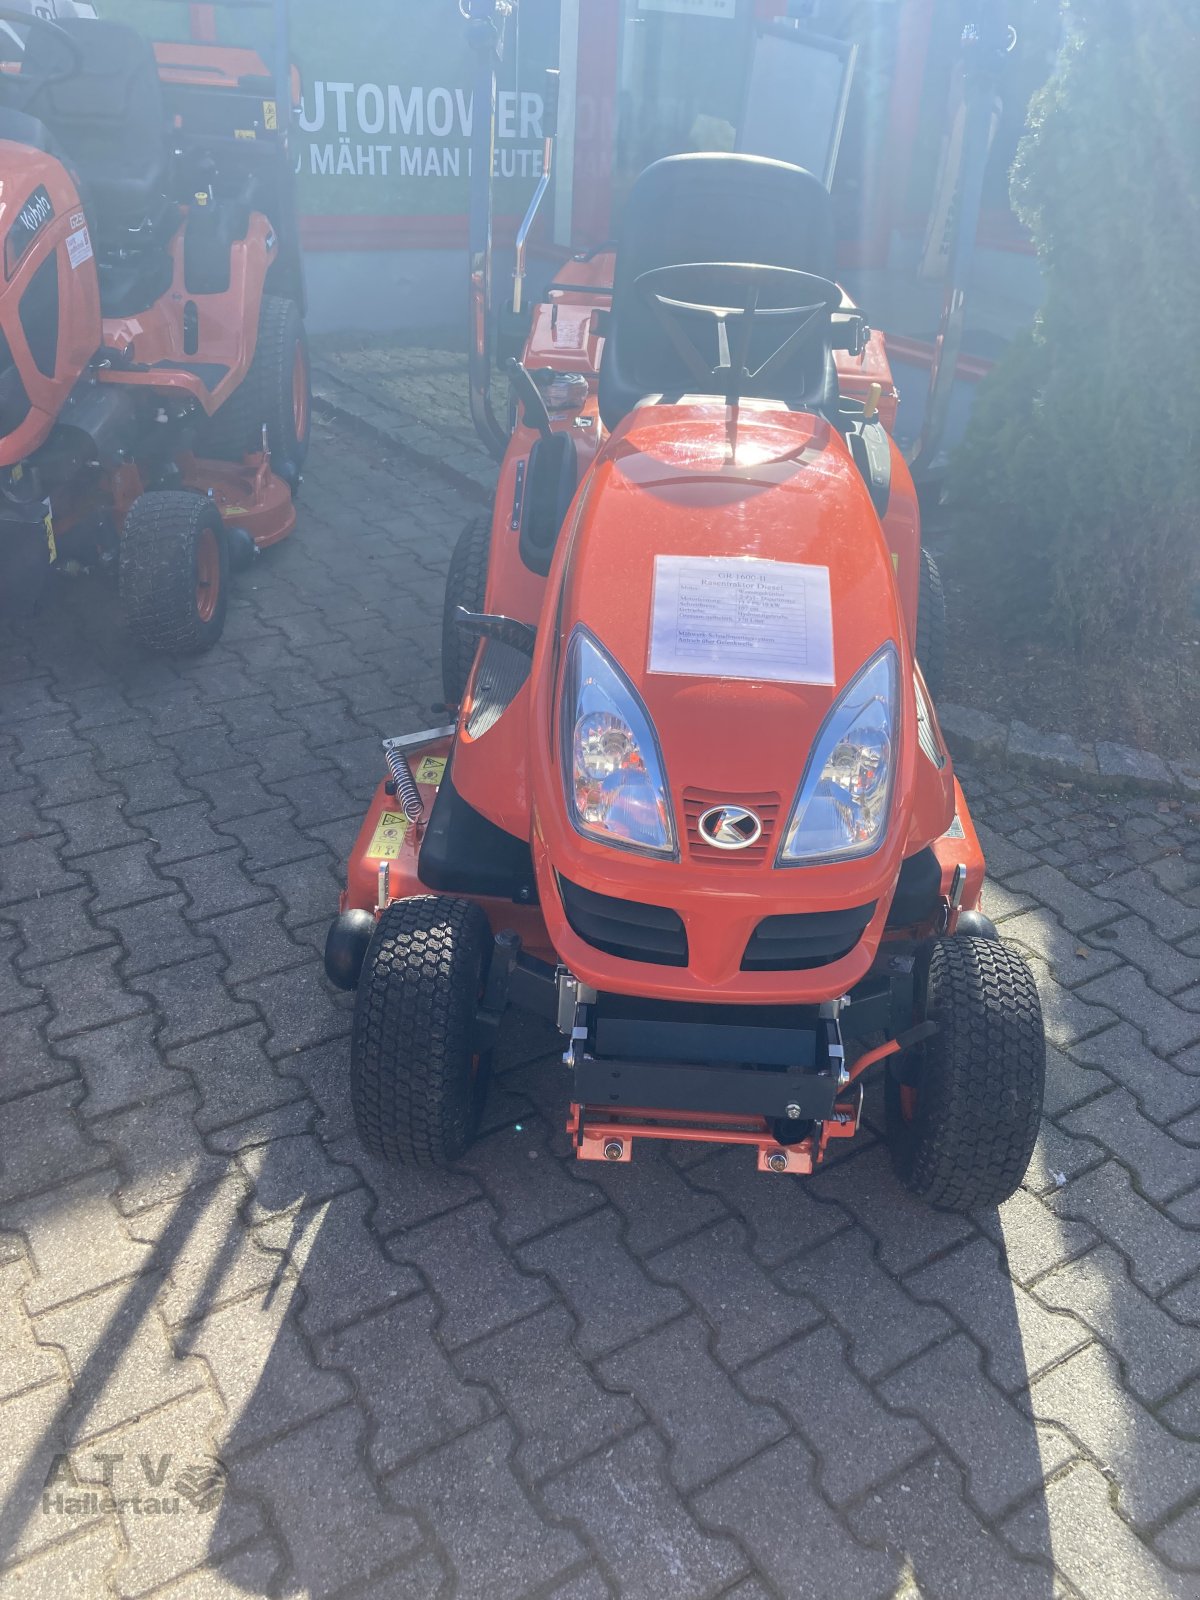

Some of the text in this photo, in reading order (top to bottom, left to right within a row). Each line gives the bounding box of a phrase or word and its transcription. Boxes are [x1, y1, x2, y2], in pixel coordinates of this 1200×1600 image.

[298, 80, 546, 139] UTOMOER
[309, 136, 392, 177] MÄHT
[399, 145, 460, 177] MAN
[468, 147, 543, 178] EUTE
[19, 195, 51, 231] Kubota
[701, 579, 784, 591] Rasentraktor Diesel
